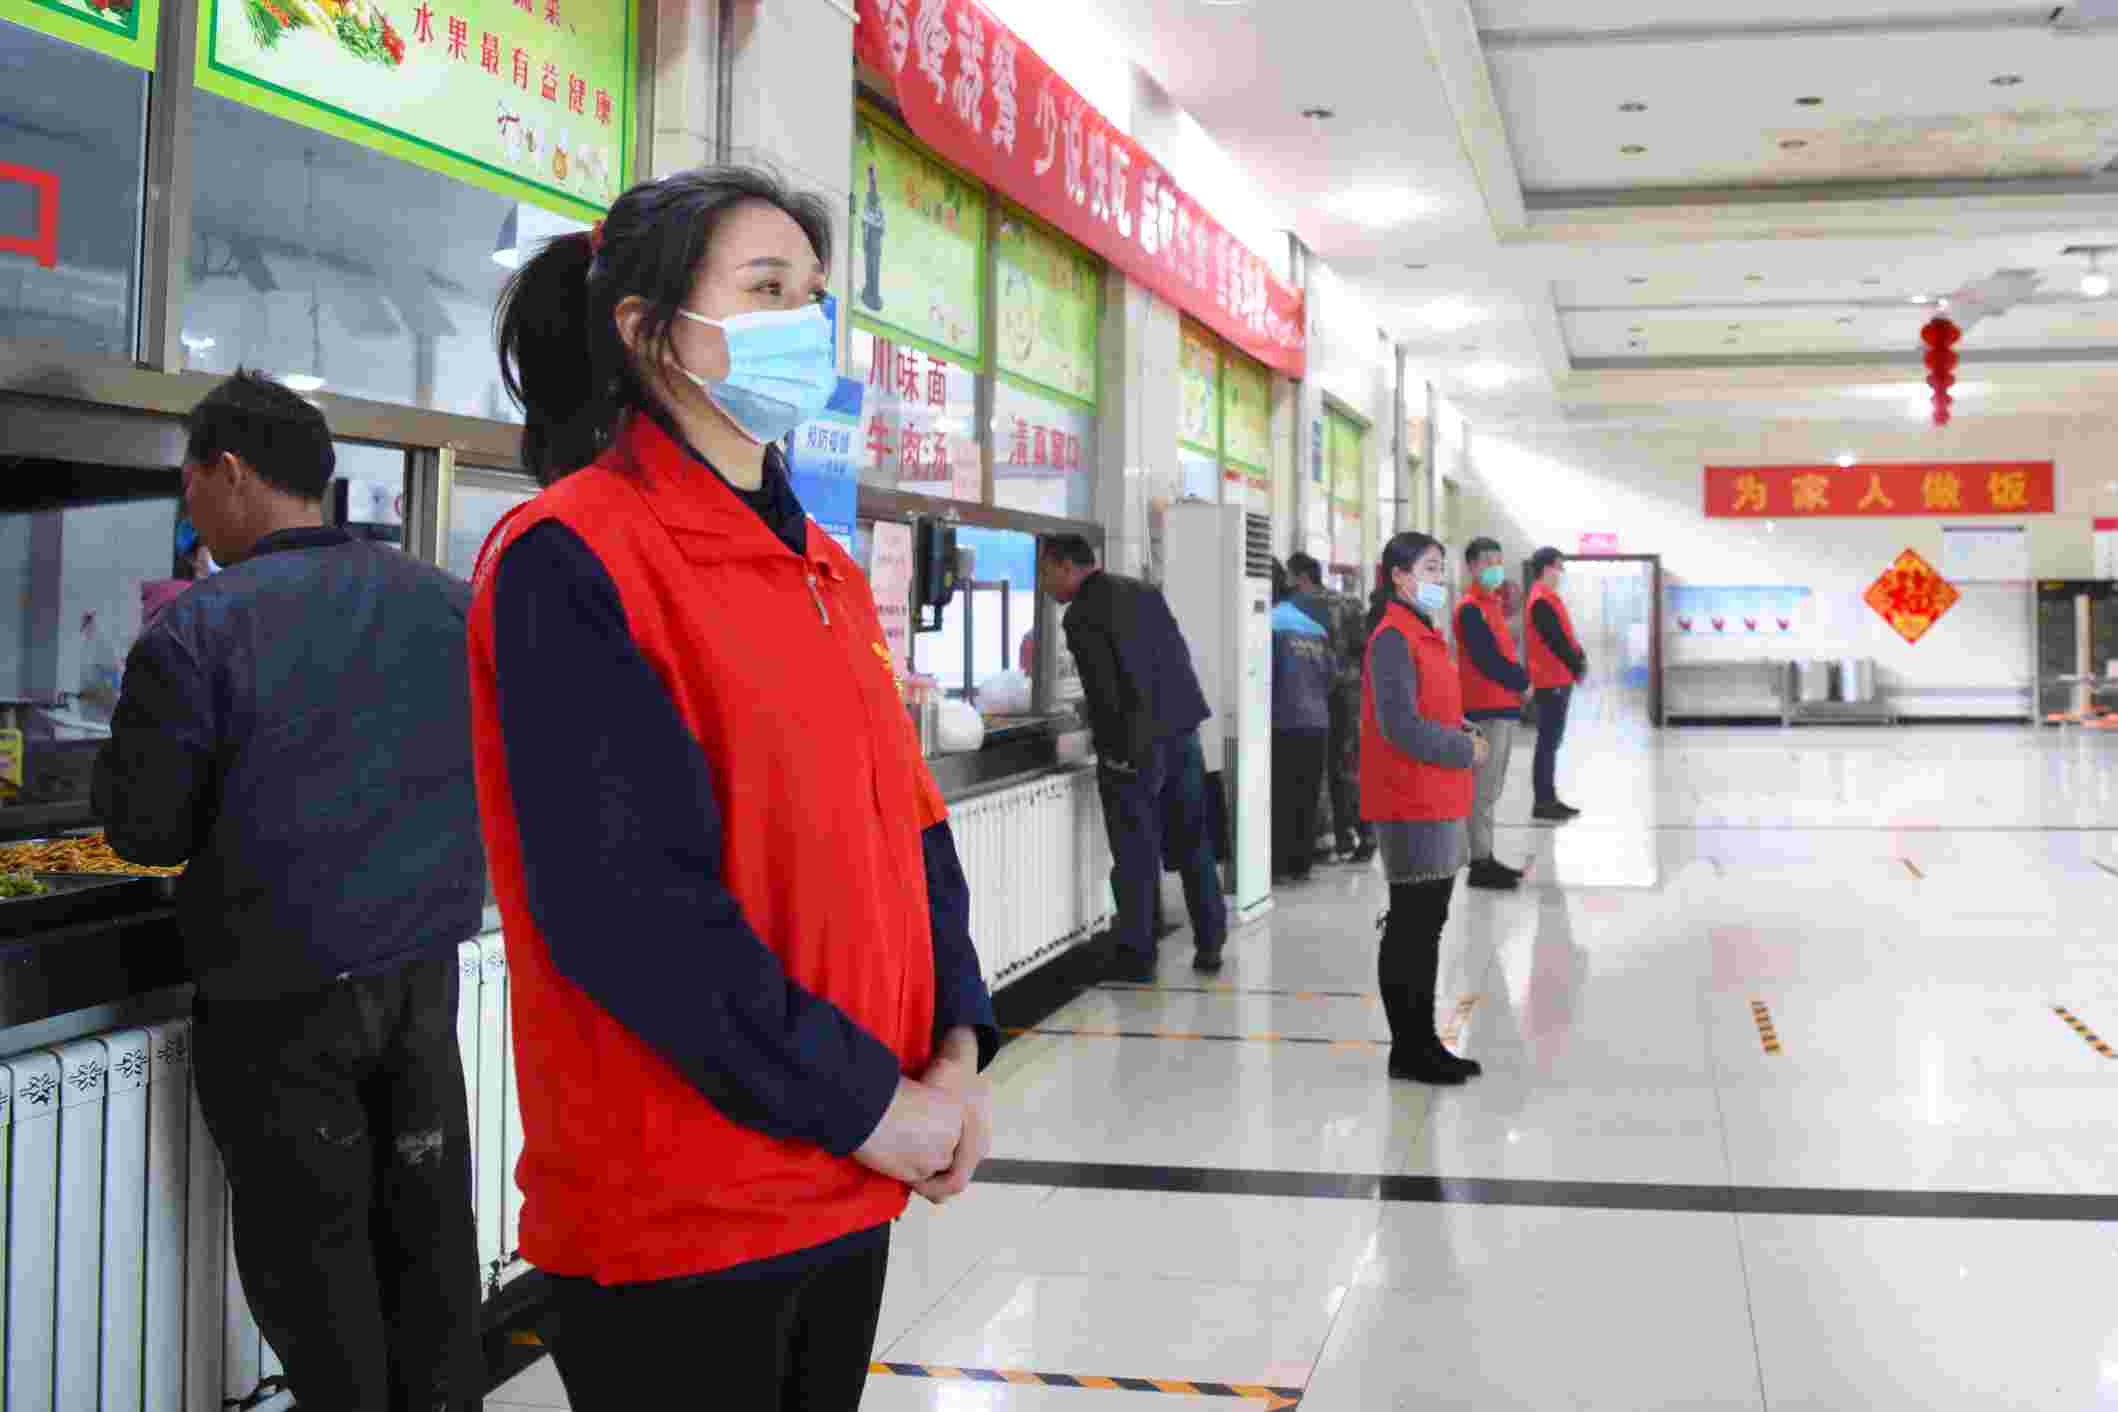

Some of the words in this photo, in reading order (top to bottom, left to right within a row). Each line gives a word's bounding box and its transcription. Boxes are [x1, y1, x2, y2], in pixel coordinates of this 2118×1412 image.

[414, 2, 612, 127] 水果最有益健康
[869, 335, 946, 406] 川味面
[1733, 472, 2028, 511] 为家人做饭
